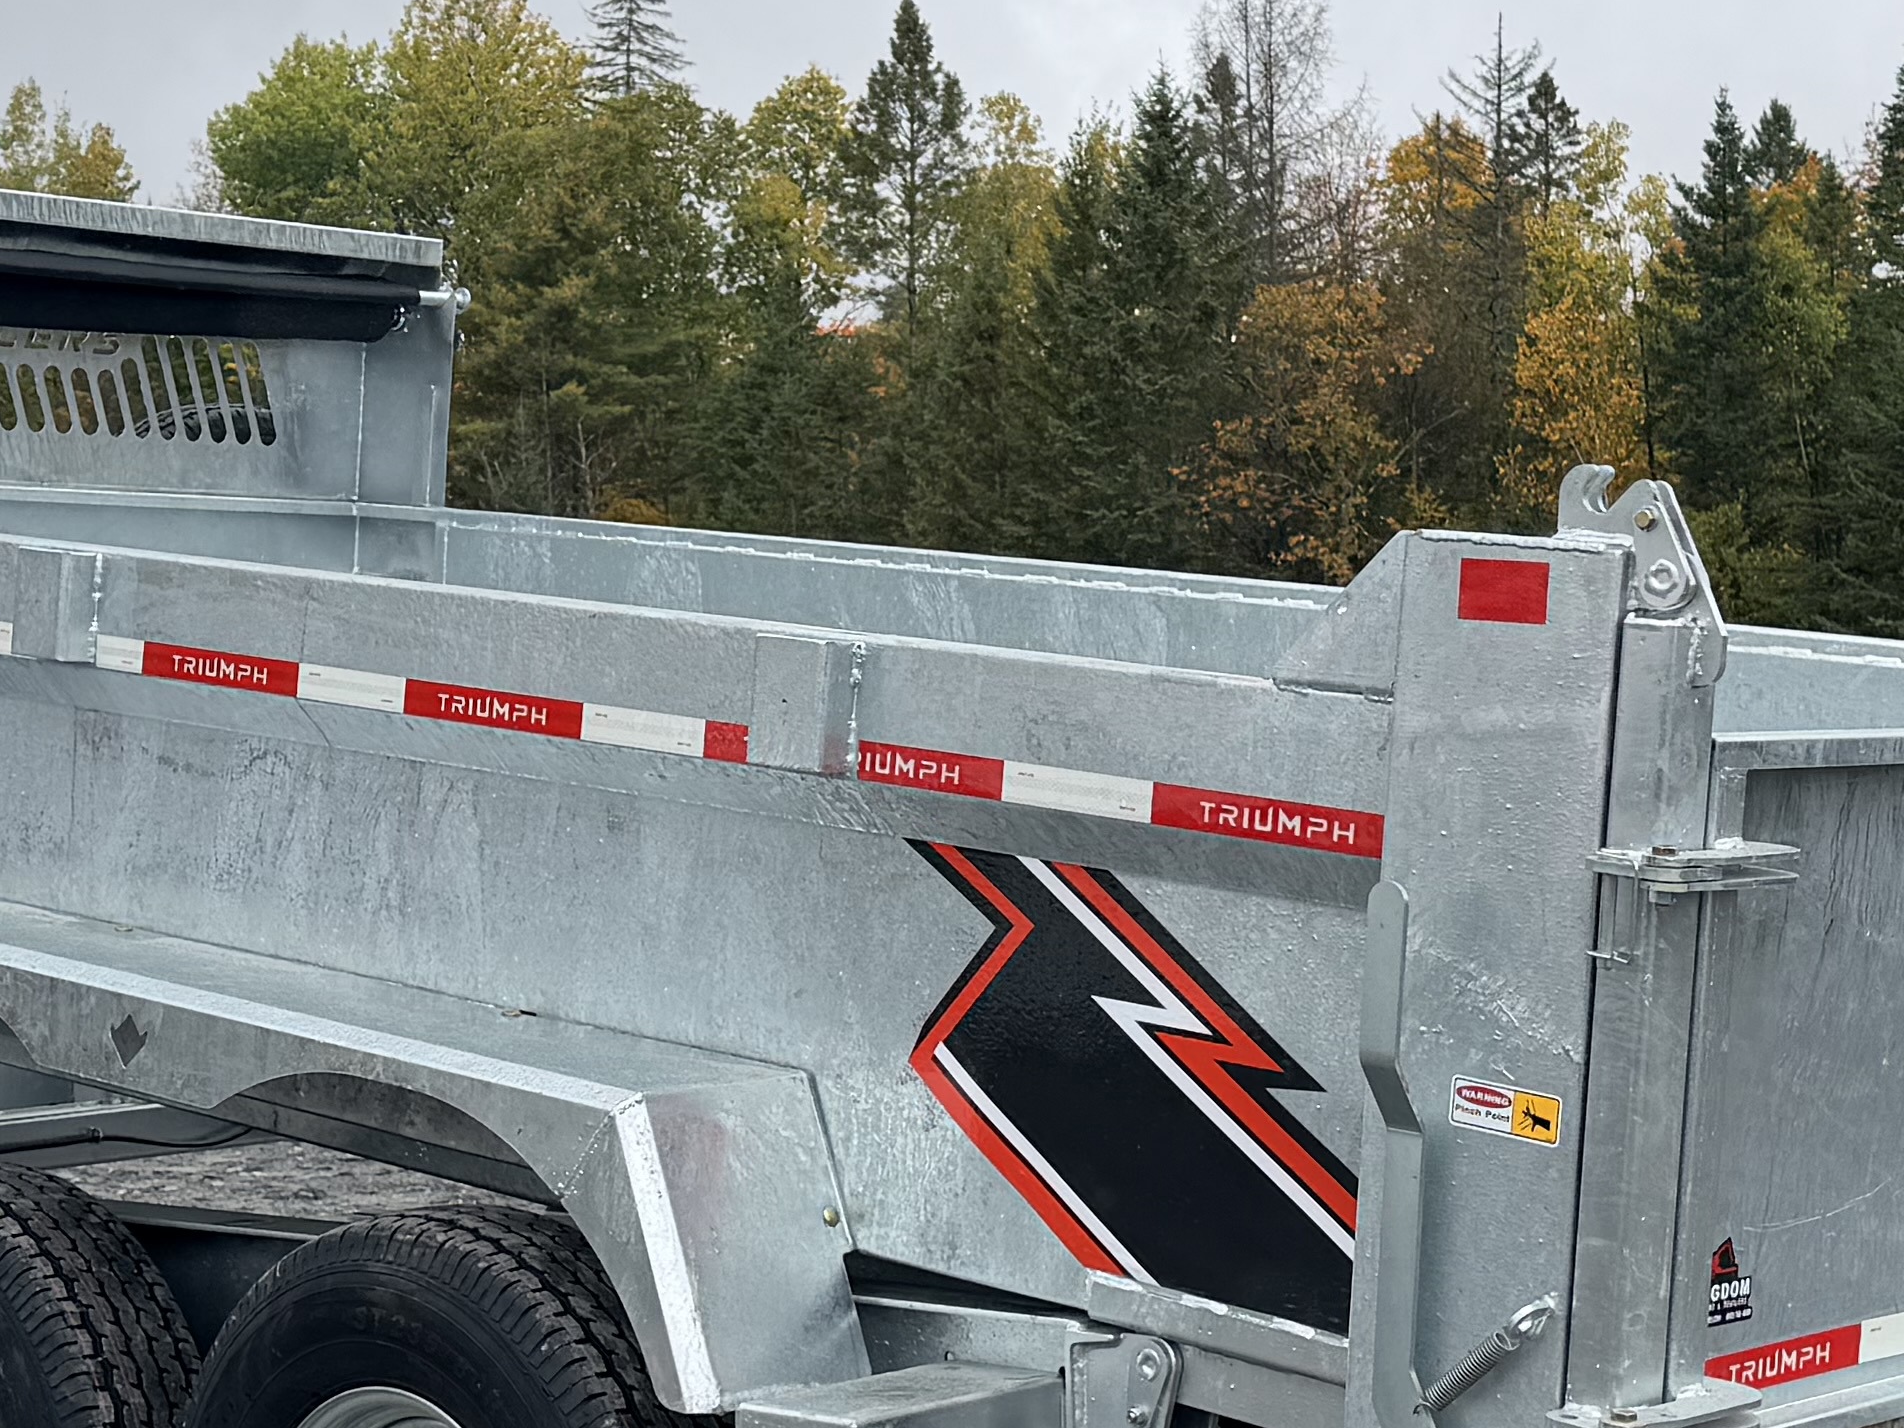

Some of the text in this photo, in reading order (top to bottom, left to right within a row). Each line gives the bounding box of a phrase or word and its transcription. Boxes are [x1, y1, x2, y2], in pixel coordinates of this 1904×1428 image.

[172, 654, 269, 686] TRIUMPH
[437, 693, 548, 726] TRIUMPH
[1200, 801, 1356, 845] TRIUMPH
[1461, 1088, 1510, 1106] WARNING
[1485, 1110, 1510, 1123] Point
[1710, 1278, 1751, 1302] GDOM
[1728, 1341, 1831, 1383] TRIUMPH
